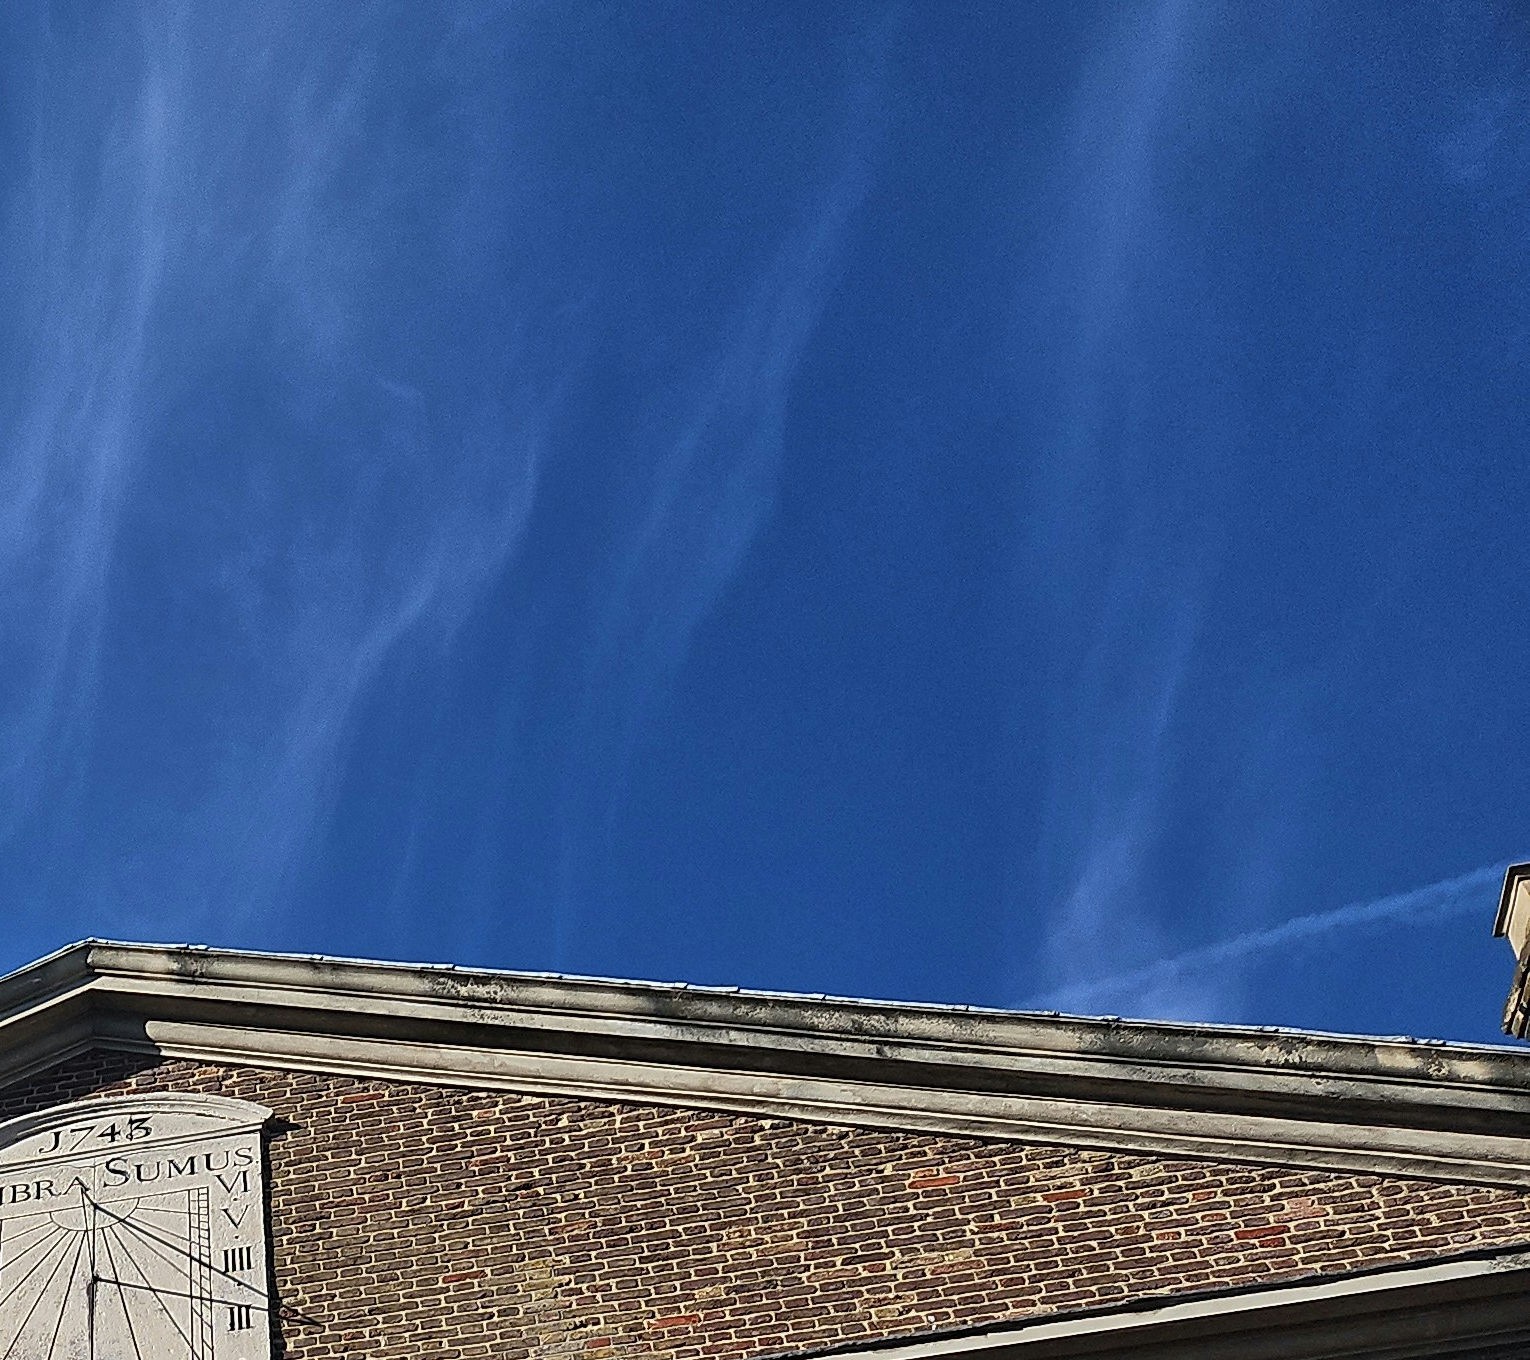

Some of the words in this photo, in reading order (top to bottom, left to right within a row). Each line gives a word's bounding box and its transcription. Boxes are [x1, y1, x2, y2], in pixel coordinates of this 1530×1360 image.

[213, 1169, 251, 1194] VI
[220, 1204, 249, 1229] V
[222, 1245, 254, 1274] IIII
[227, 1304, 254, 1332] III
